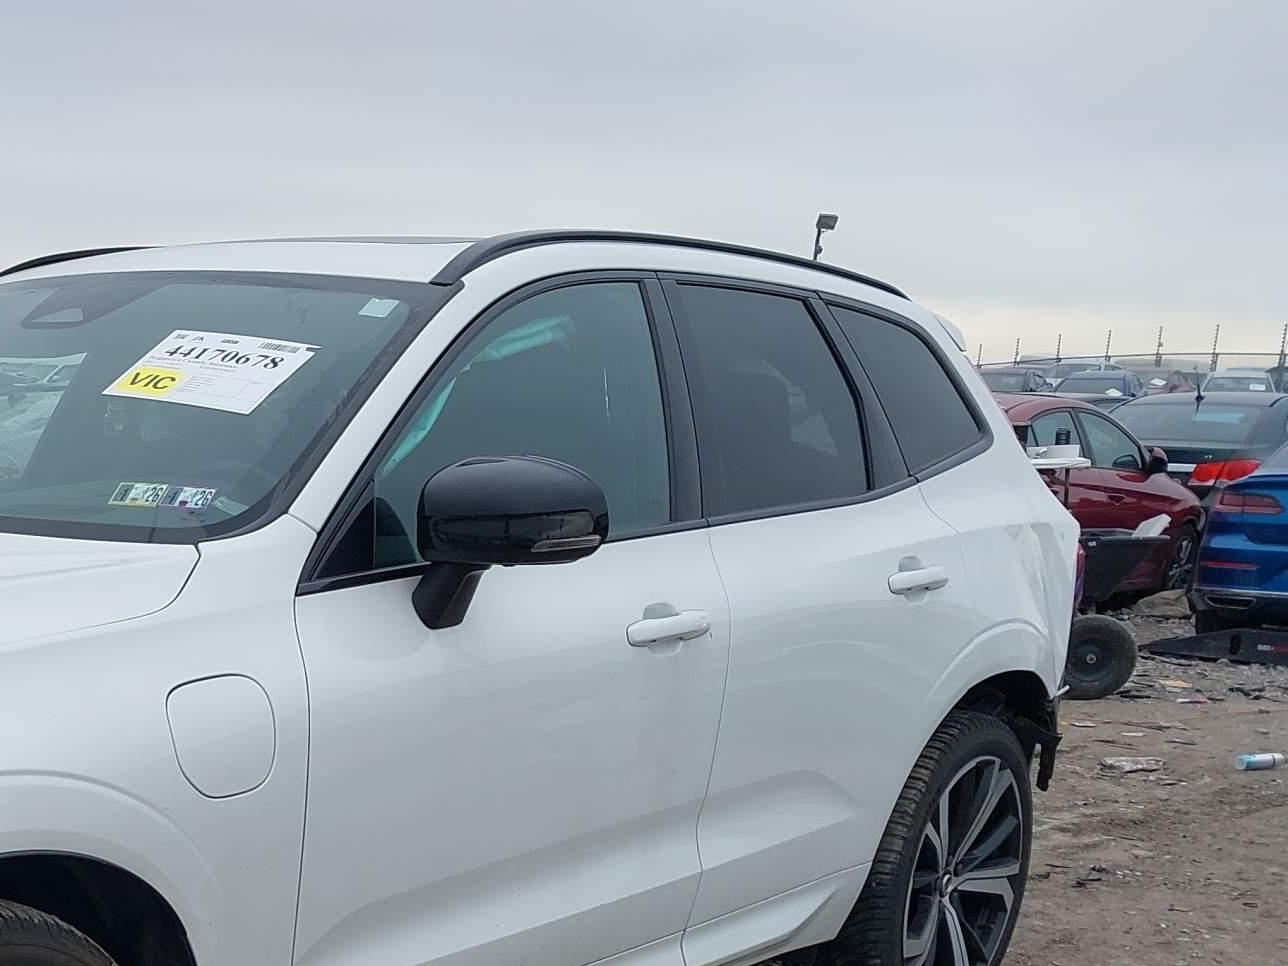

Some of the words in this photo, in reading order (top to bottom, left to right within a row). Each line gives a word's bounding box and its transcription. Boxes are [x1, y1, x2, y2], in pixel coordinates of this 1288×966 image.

[165, 344, 285, 370] 44170678
[129, 372, 176, 389] VIC
[146, 486, 163, 503] 26
[195, 490, 212, 507] 26
